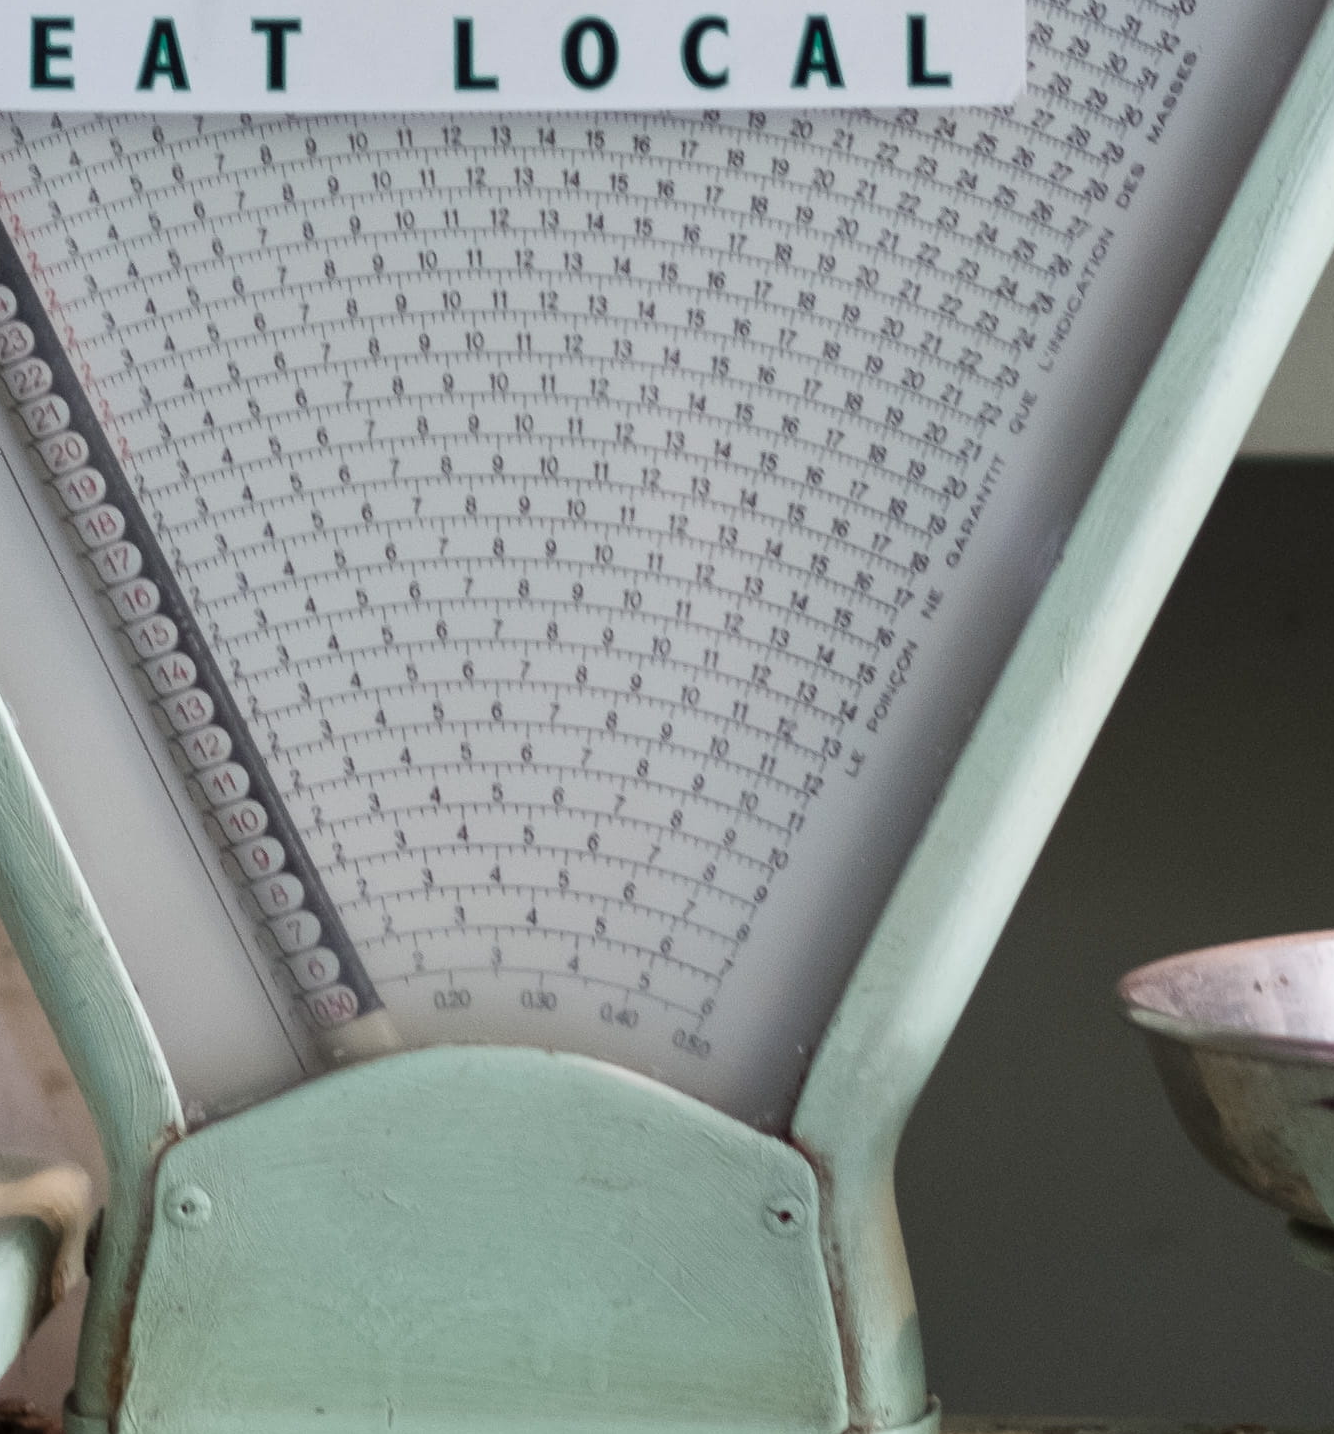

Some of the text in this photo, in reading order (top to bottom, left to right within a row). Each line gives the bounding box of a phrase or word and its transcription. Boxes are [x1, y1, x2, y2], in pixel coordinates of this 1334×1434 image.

[28, 13, 955, 92] EAT LOCAL
[13, 363, 44, 396] 22
[30, 400, 63, 432] 21
[49, 437, 83, 468] 20
[67, 474, 98, 503] 19
[844, 747, 866, 779] LE
[920, 586, 945, 621] NE
[945, 452, 1006, 569] GARANTIT
[1008, 388, 1039, 435] QUE
[1037, 226, 1115, 374] L'INDICATION
[86, 510, 117, 539] 18
[104, 546, 130, 576] 17
[122, 586, 152, 614] 16
[140, 622, 170, 651] 15
[157, 660, 189, 688] 14
[174, 695, 207, 725] 13
[192, 732, 221, 761] 12
[212, 770, 240, 796] 11
[229, 807, 260, 836] 10
[251, 845, 271, 872] 9
[269, 883, 290, 908] 8
[285, 918, 302, 944] 7
[307, 957, 327, 978] 6
